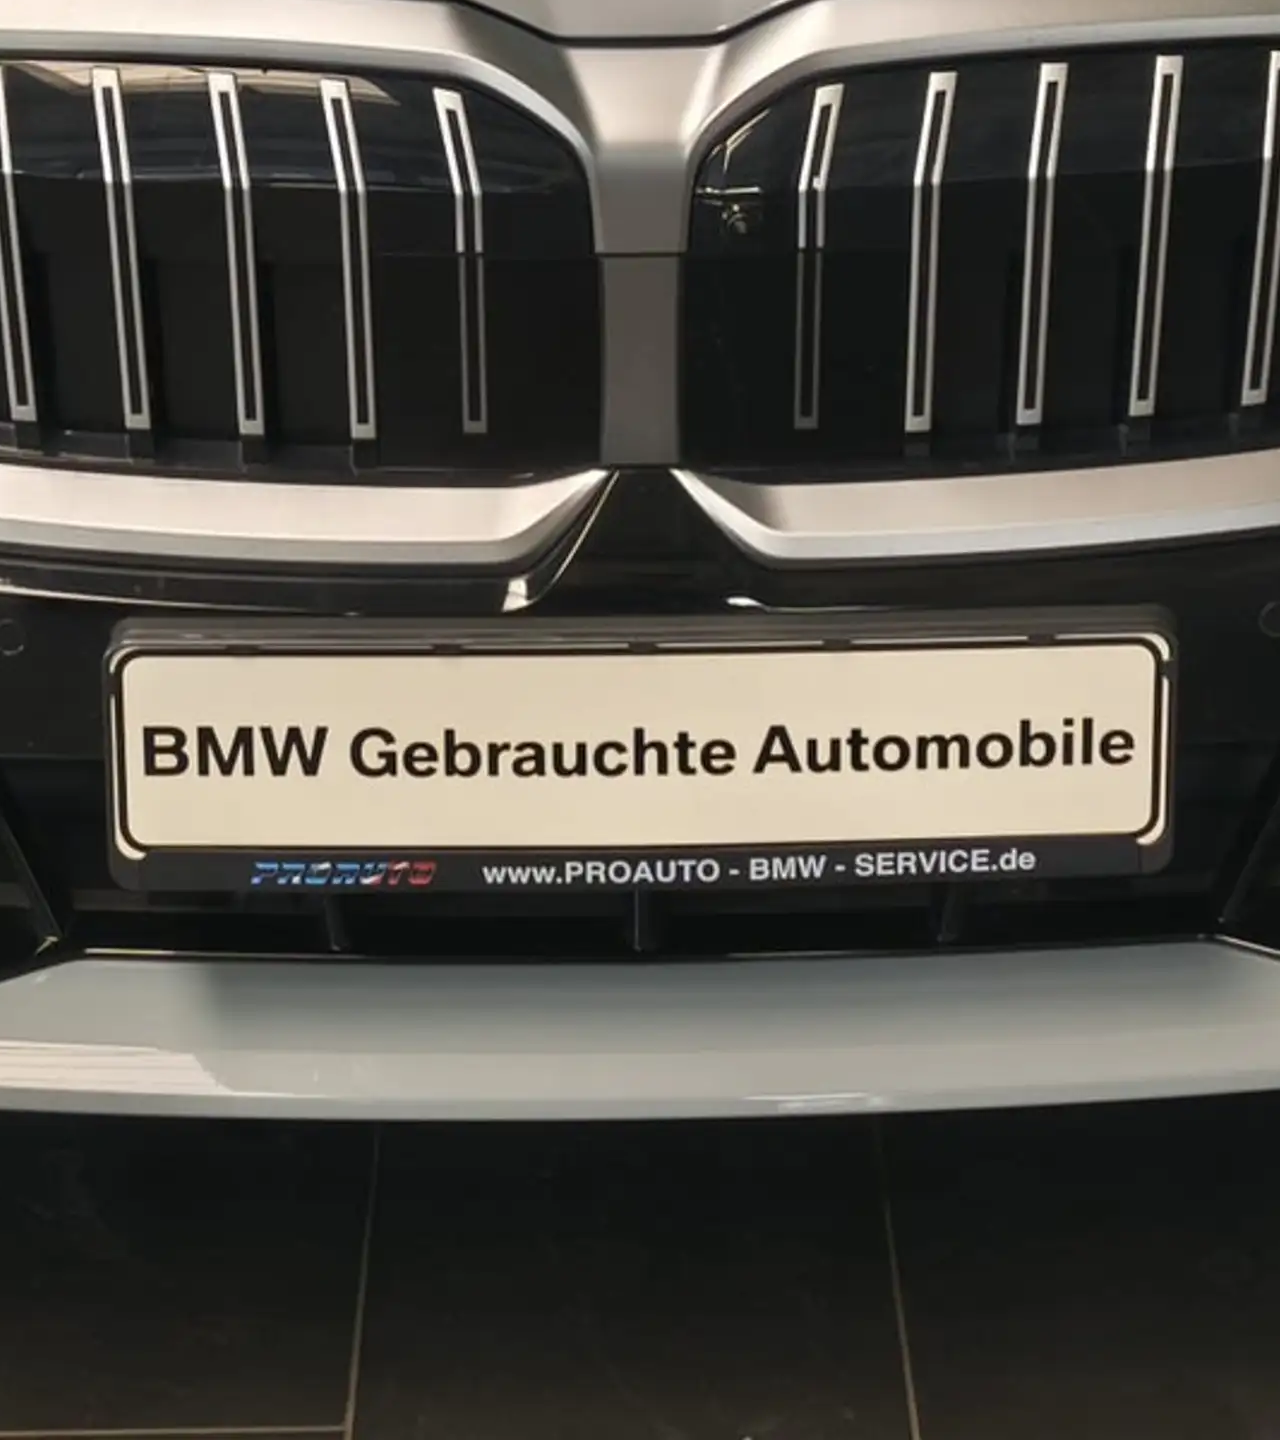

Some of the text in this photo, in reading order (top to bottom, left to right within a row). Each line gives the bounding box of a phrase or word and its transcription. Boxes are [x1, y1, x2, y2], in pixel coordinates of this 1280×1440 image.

[142, 716, 1135, 778] BMW Gebrauchte Automobile
[250, 861, 437, 885] PROAUTO
[482, 858, 720, 885] www.PROAUTO
[749, 854, 827, 881] BMW
[854, 847, 1036, 877] SERVICE.de
